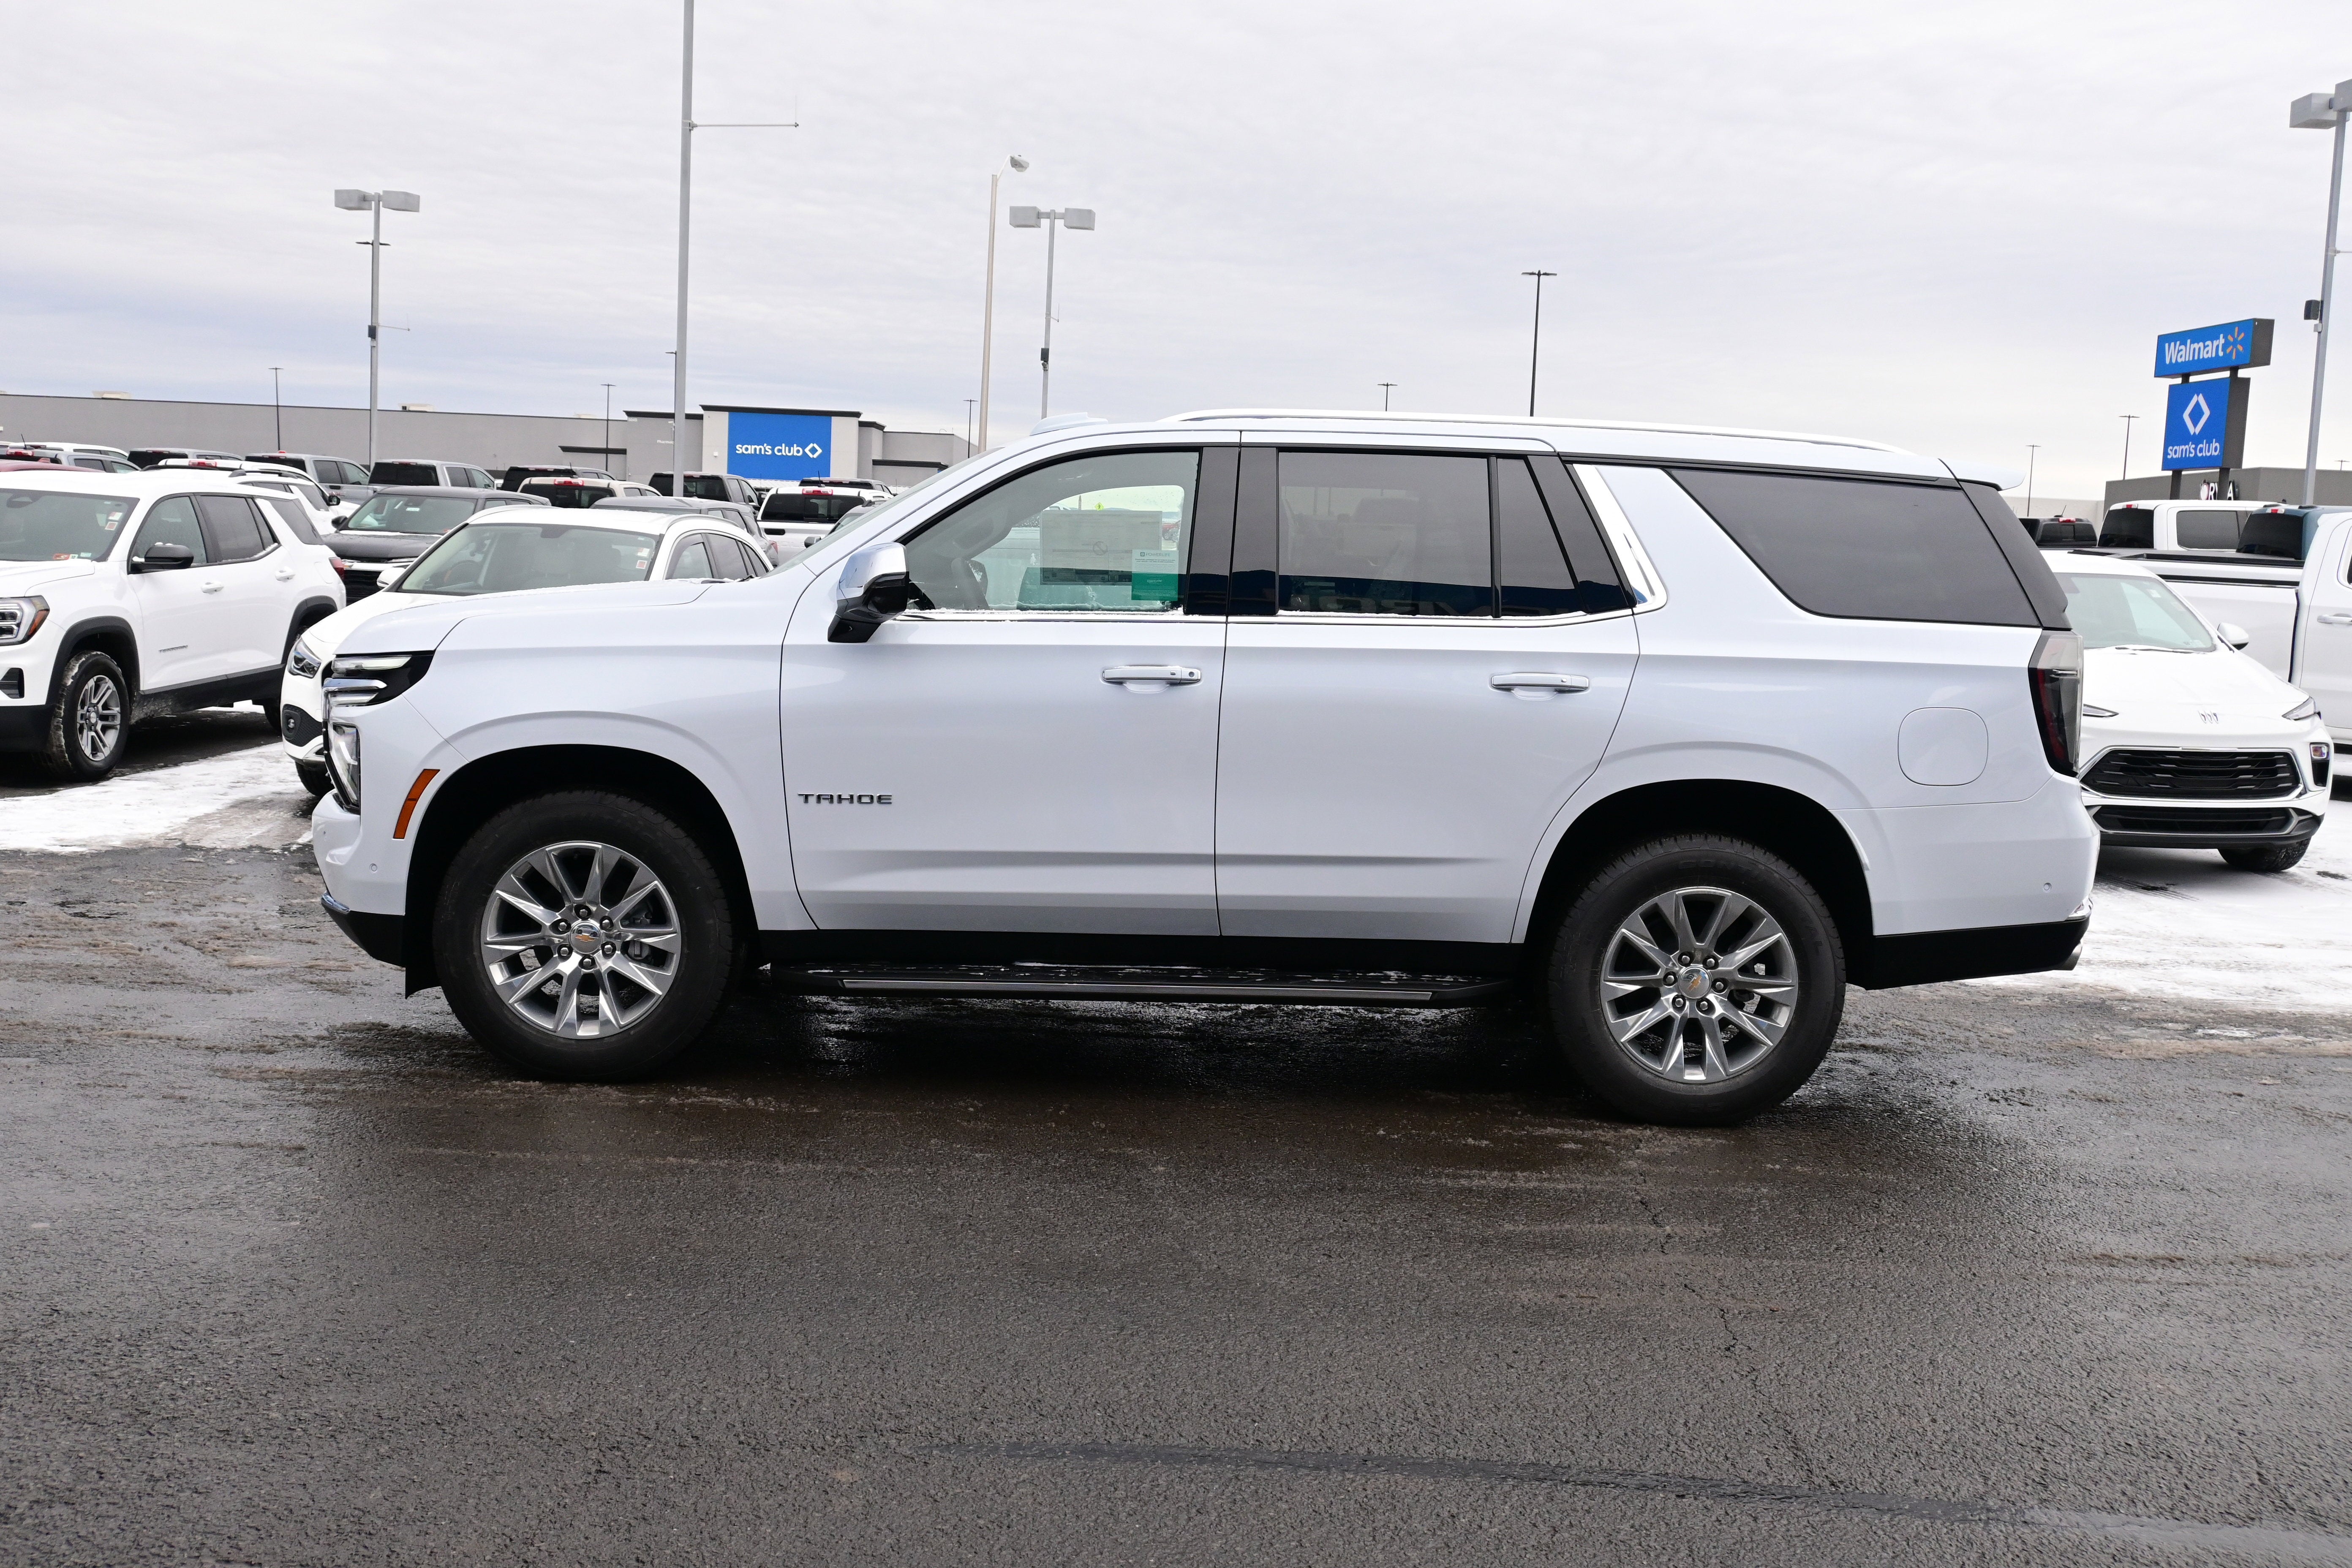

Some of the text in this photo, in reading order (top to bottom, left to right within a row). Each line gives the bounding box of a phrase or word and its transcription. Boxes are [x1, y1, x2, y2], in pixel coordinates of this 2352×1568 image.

[2165, 334, 2224, 364] Walmart
[735, 443, 803, 456] sam's club
[2167, 439, 2219, 458] sam's club
[798, 793, 892, 804] TAHOE
